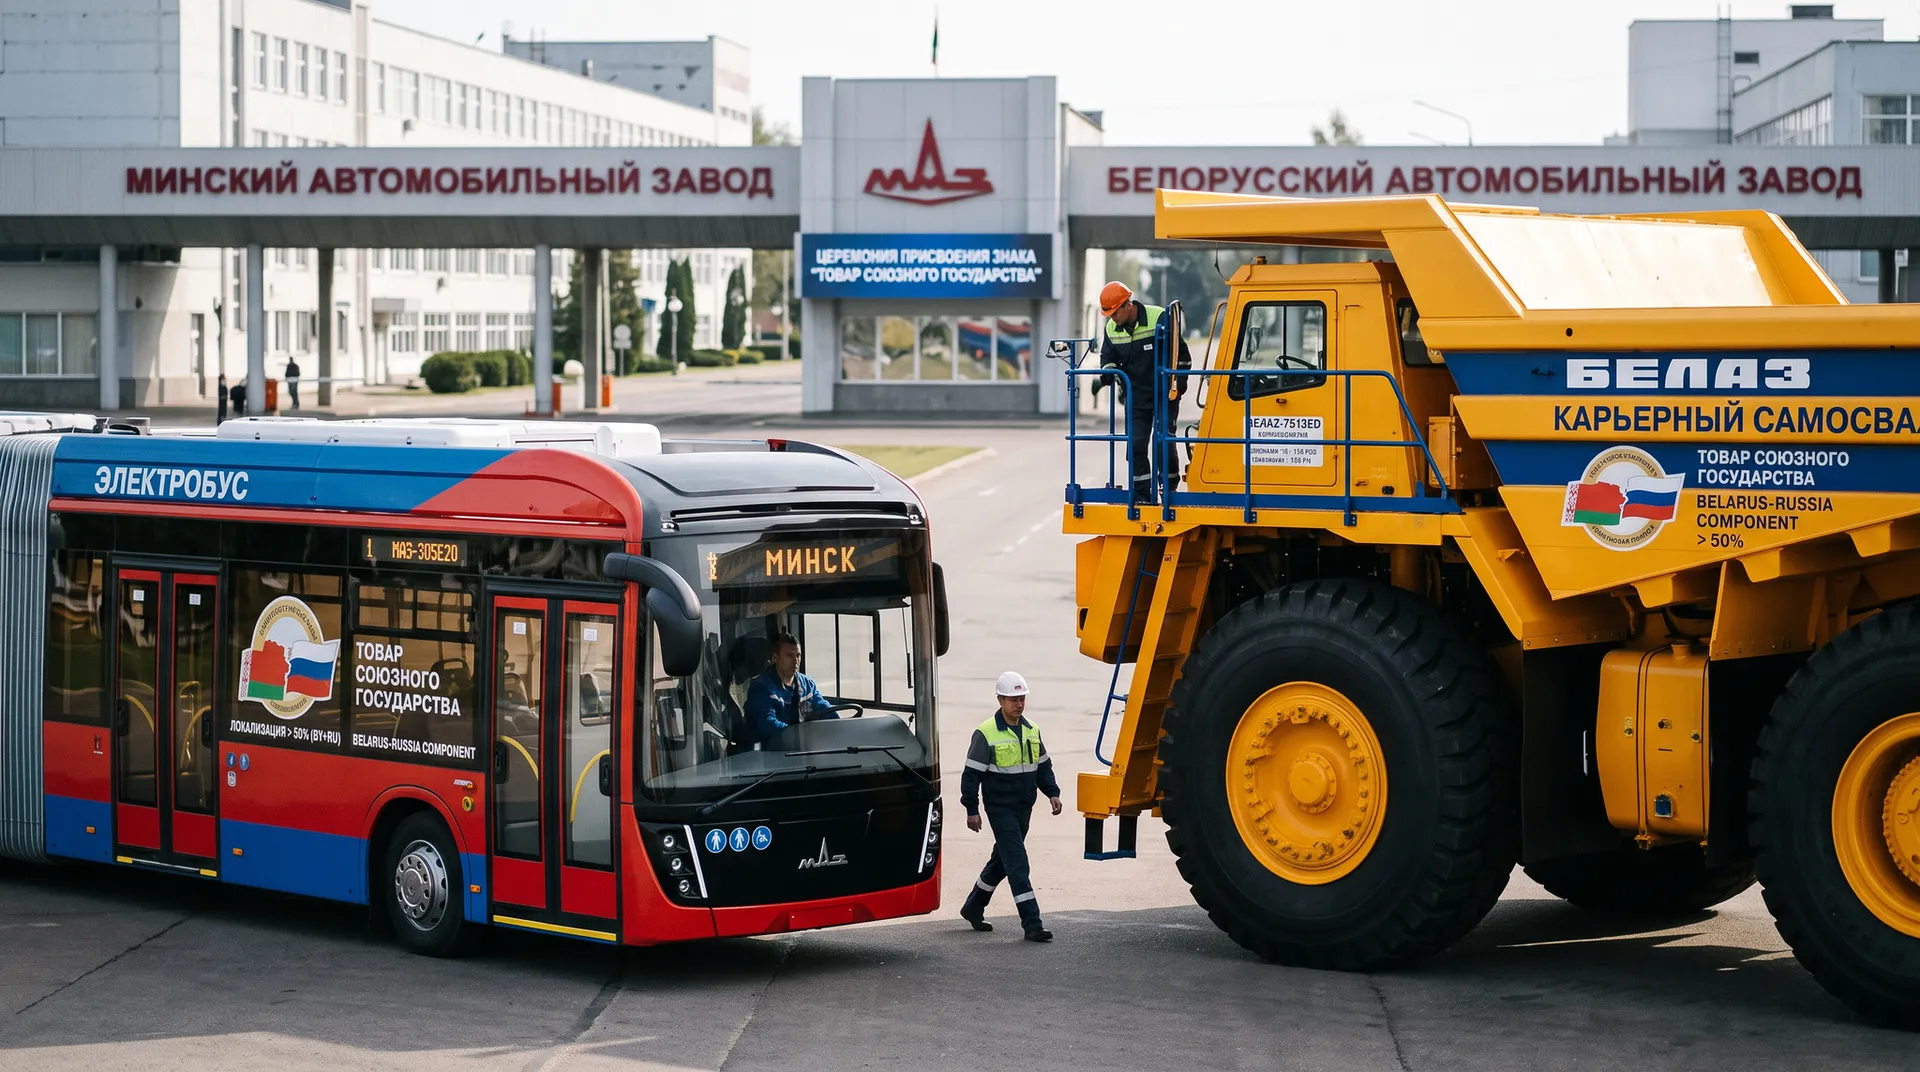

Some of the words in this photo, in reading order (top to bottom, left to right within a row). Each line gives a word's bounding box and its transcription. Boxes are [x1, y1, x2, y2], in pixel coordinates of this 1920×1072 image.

[126, 160, 297, 194] МИНСКИЙ
[308, 160, 640, 194] АВТОМОБИЛЬНЫЙ
[651, 167, 774, 199] ЗАВОД
[1107, 160, 1373, 194] БЕЛОРУССКИЙ
[1385, 160, 1726, 194] АВТОМОБИЛЬНЫЙ
[1737, 167, 1863, 199] ЗАВОД
[816, 249, 898, 265] ЦЕРЕМОНИЯ
[900, 249, 990, 264] ПРИСВОЕНИЯ
[992, 249, 1037, 264] ЗНАКА
[863, 268, 939, 283] СОЮЗНОГО
[1566, 358, 1811, 389] БЕЛАЗ
[1554, 400, 1744, 434] КАРЬЕРНЫЙ
[1753, 406, 1920, 435] САМОСВА
[1697, 449, 1751, 465] ТОВАР
[1754, 450, 1850, 467] СОЮЗНОГО
[94, 465, 249, 501] ЭЛЕКТРОБУС
[1697, 469, 1815, 488] ГОСУДАРСТВА
[1696, 494, 1834, 512] BELARUS-RUSSIA
[1696, 513, 1799, 530] COMPONENT
[1710, 533, 1744, 548] 50%
[765, 546, 856, 577] МИНСК
[356, 641, 403, 663] ТОВАР
[355, 664, 440, 690] СОЮЗНОГО
[355, 688, 461, 716] ГОСУДАРСТВА
[230, 720, 286, 738] ЛОКАЛИЗАЦИЯ
[293, 727, 309, 740] 50%
[310, 729, 341, 747] (BY+RU)
[352, 733, 421, 753] BELARUS-RUSSIA
[422, 741, 476, 760] COMPONENT
